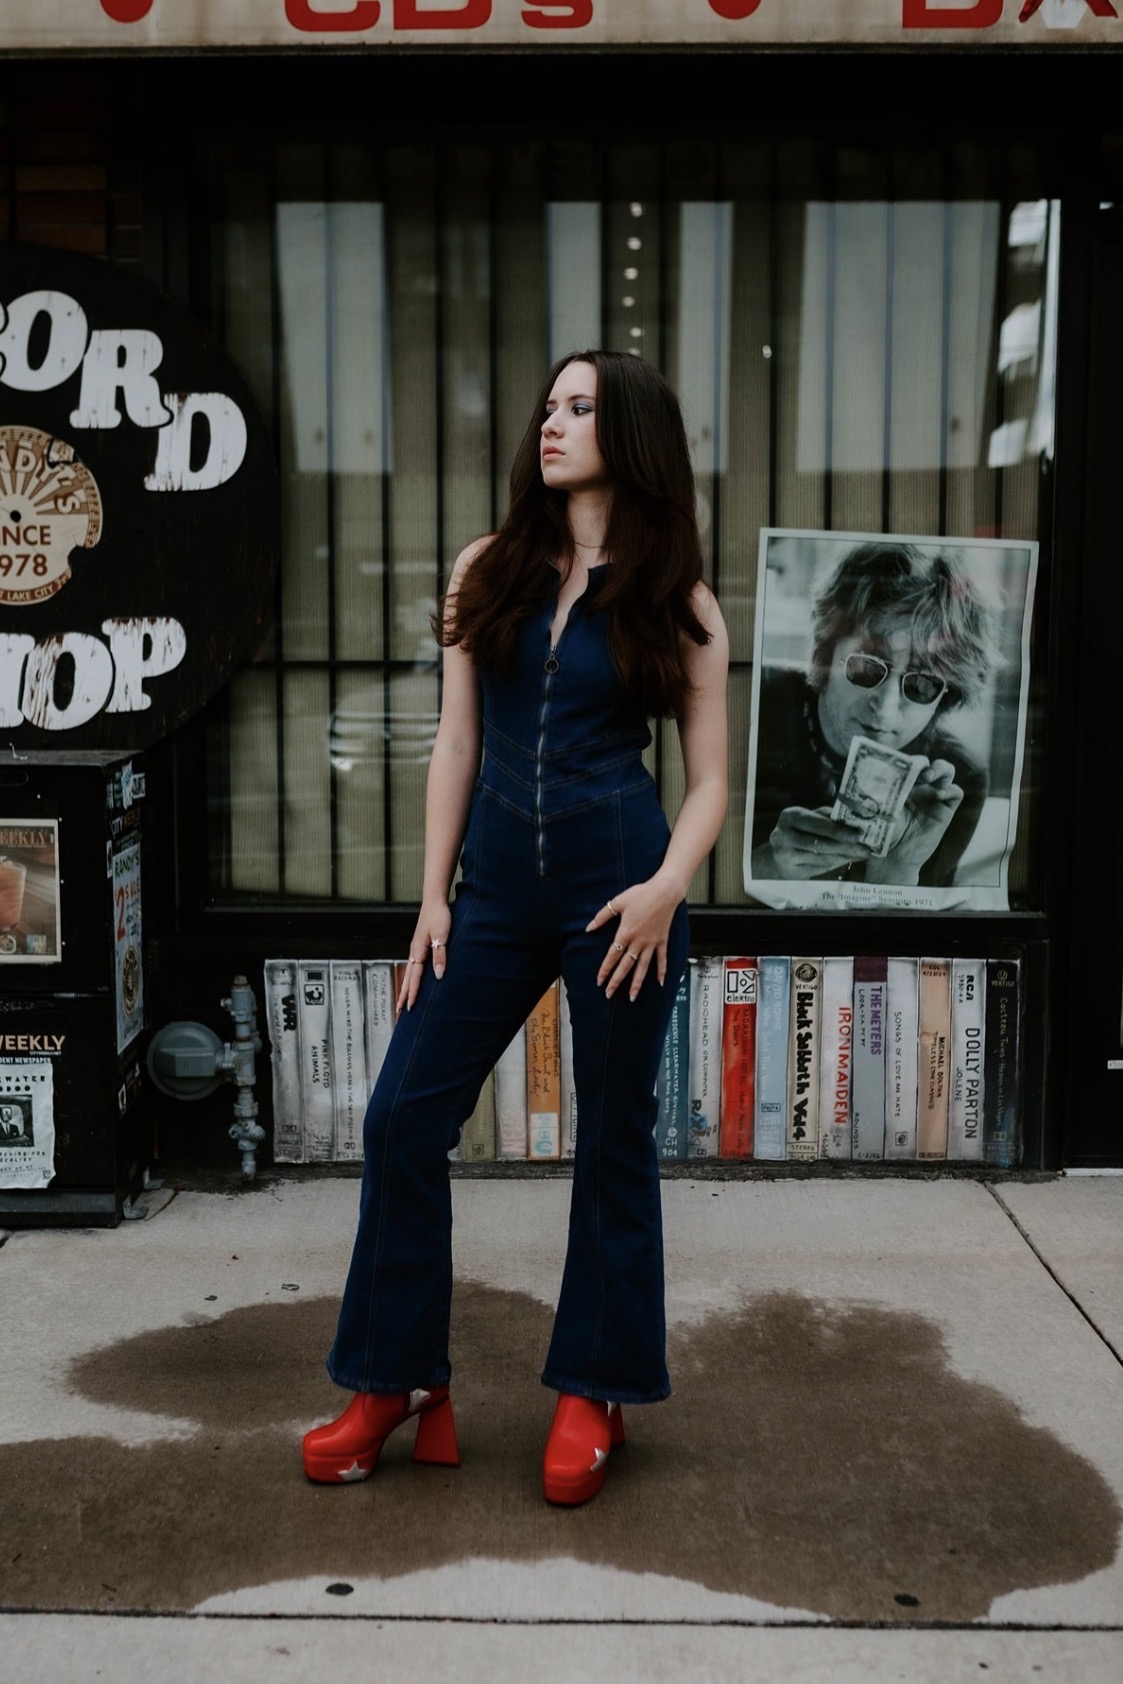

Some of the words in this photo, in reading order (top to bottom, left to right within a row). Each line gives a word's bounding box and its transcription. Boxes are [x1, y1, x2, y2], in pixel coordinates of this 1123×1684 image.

[0, 290, 248, 492] ORD
[0, 526, 52, 546] NCE
[7, 590, 31, 600] LAKE
[34, 584, 53, 599] CITY
[822, 891, 835, 900] The
[852, 886, 871, 894] John
[873, 888, 903, 896] Lennon
[870, 986, 882, 1008] THE
[966, 975, 974, 1001] RCA
[702, 984, 710, 1047] RADIOHEAD
[733, 1009, 741, 1022] The
[838, 1006, 851, 1050] IRON
[894, 1010, 902, 1044] SONGS
[870, 1010, 881, 1056] METERS
[321, 1039, 329, 1060] PINK
[702, 1050, 709, 1062] OK
[895, 1047, 901, 1057] OF
[937, 1036, 946, 1069] MICHAEL
[965, 1028, 981, 1075] DOLLY
[311, 1045, 320, 1083] ANIMALS
[322, 1061, 330, 1088] FLOYD
[796, 1032, 813, 1095] Sabbath
[834, 1053, 849, 1124] MAIDEN
[936, 1071, 944, 1098] BOLTON
[954, 1067, 962, 1102] JOLENE
[964, 1080, 979, 1139] PARTON
[665, 1138, 678, 1146] CH
